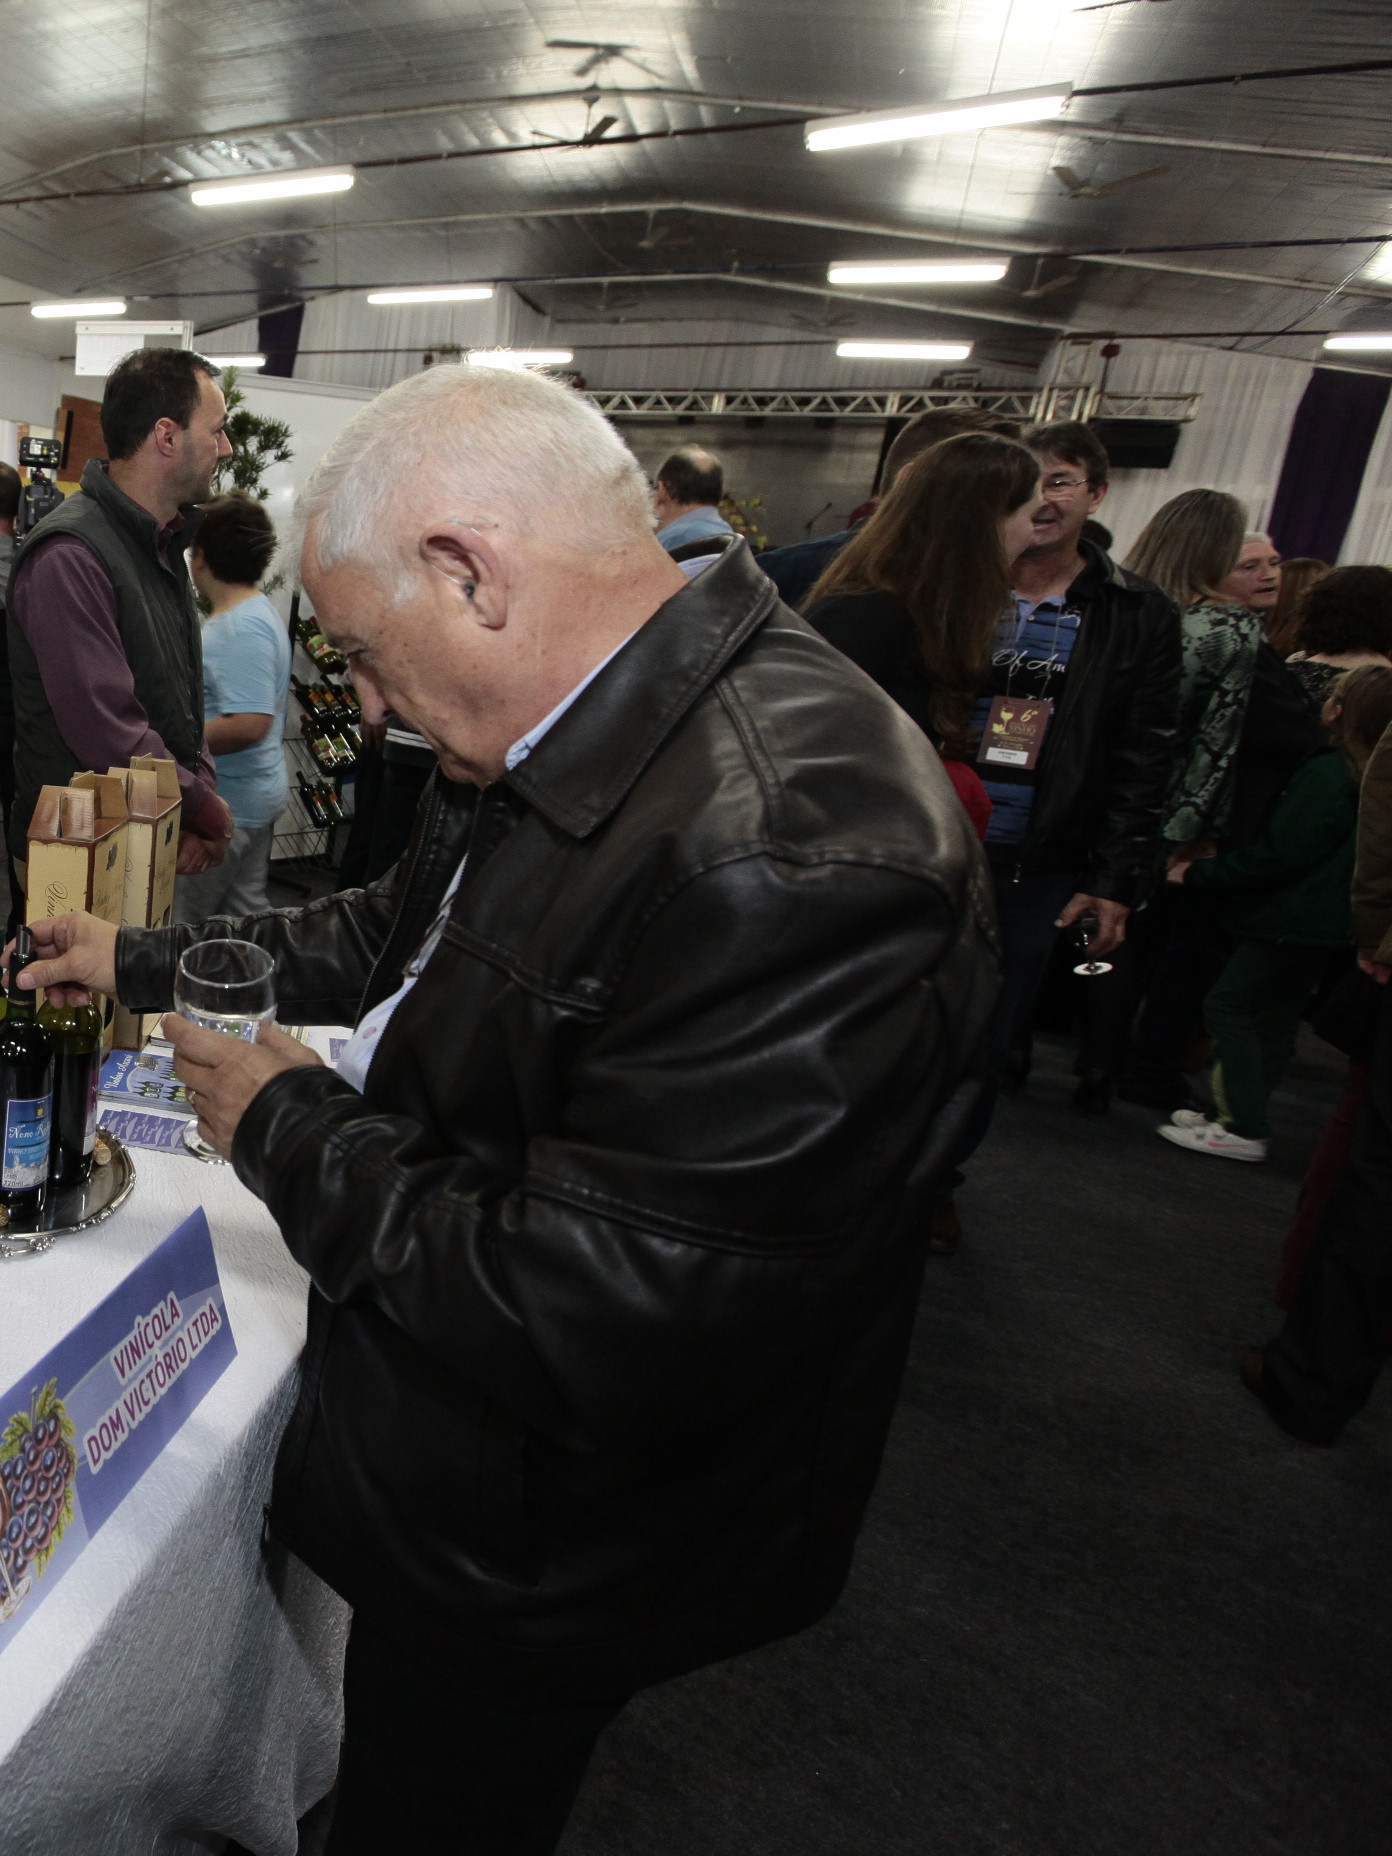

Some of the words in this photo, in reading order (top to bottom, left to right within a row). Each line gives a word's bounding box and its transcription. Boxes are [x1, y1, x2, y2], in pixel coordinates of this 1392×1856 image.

[87, 1408, 125, 1467] DOM
[124, 1341, 188, 1420] VICTÓRIO
[187, 1303, 219, 1352] LTDA
[114, 1297, 180, 1379] VINÍCOLA
